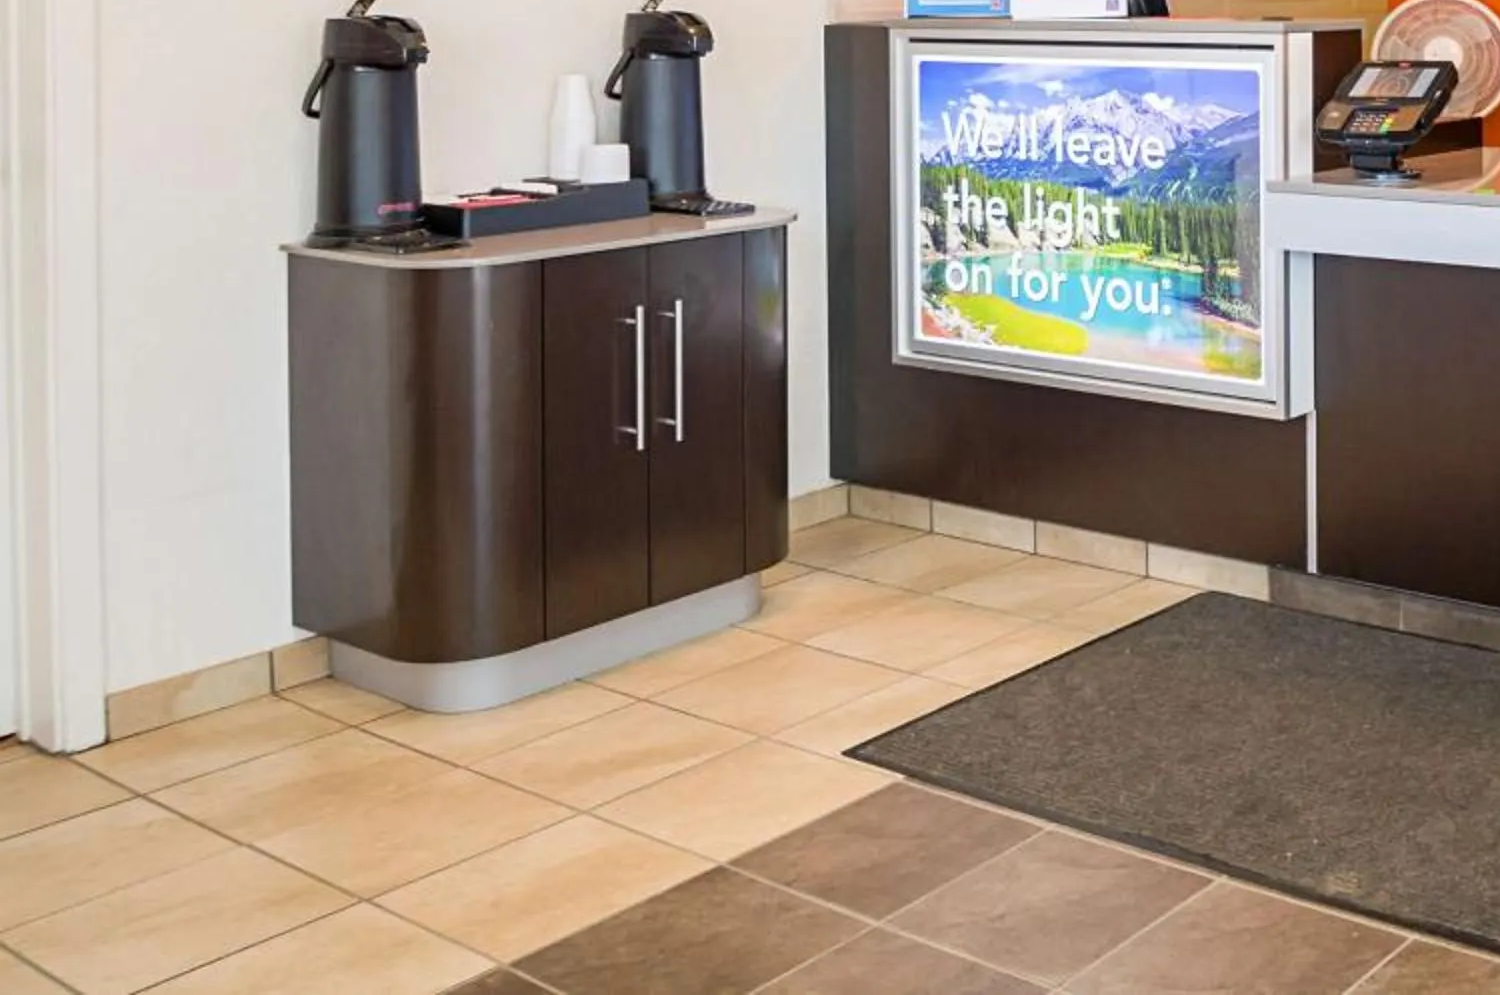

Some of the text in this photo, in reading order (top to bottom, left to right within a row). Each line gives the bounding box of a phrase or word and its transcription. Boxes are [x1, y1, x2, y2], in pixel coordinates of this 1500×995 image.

[1054, 113, 1167, 170] leave
[942, 177, 1121, 248] the light
[946, 260, 992, 294] on
[1008, 253, 1068, 303] for
